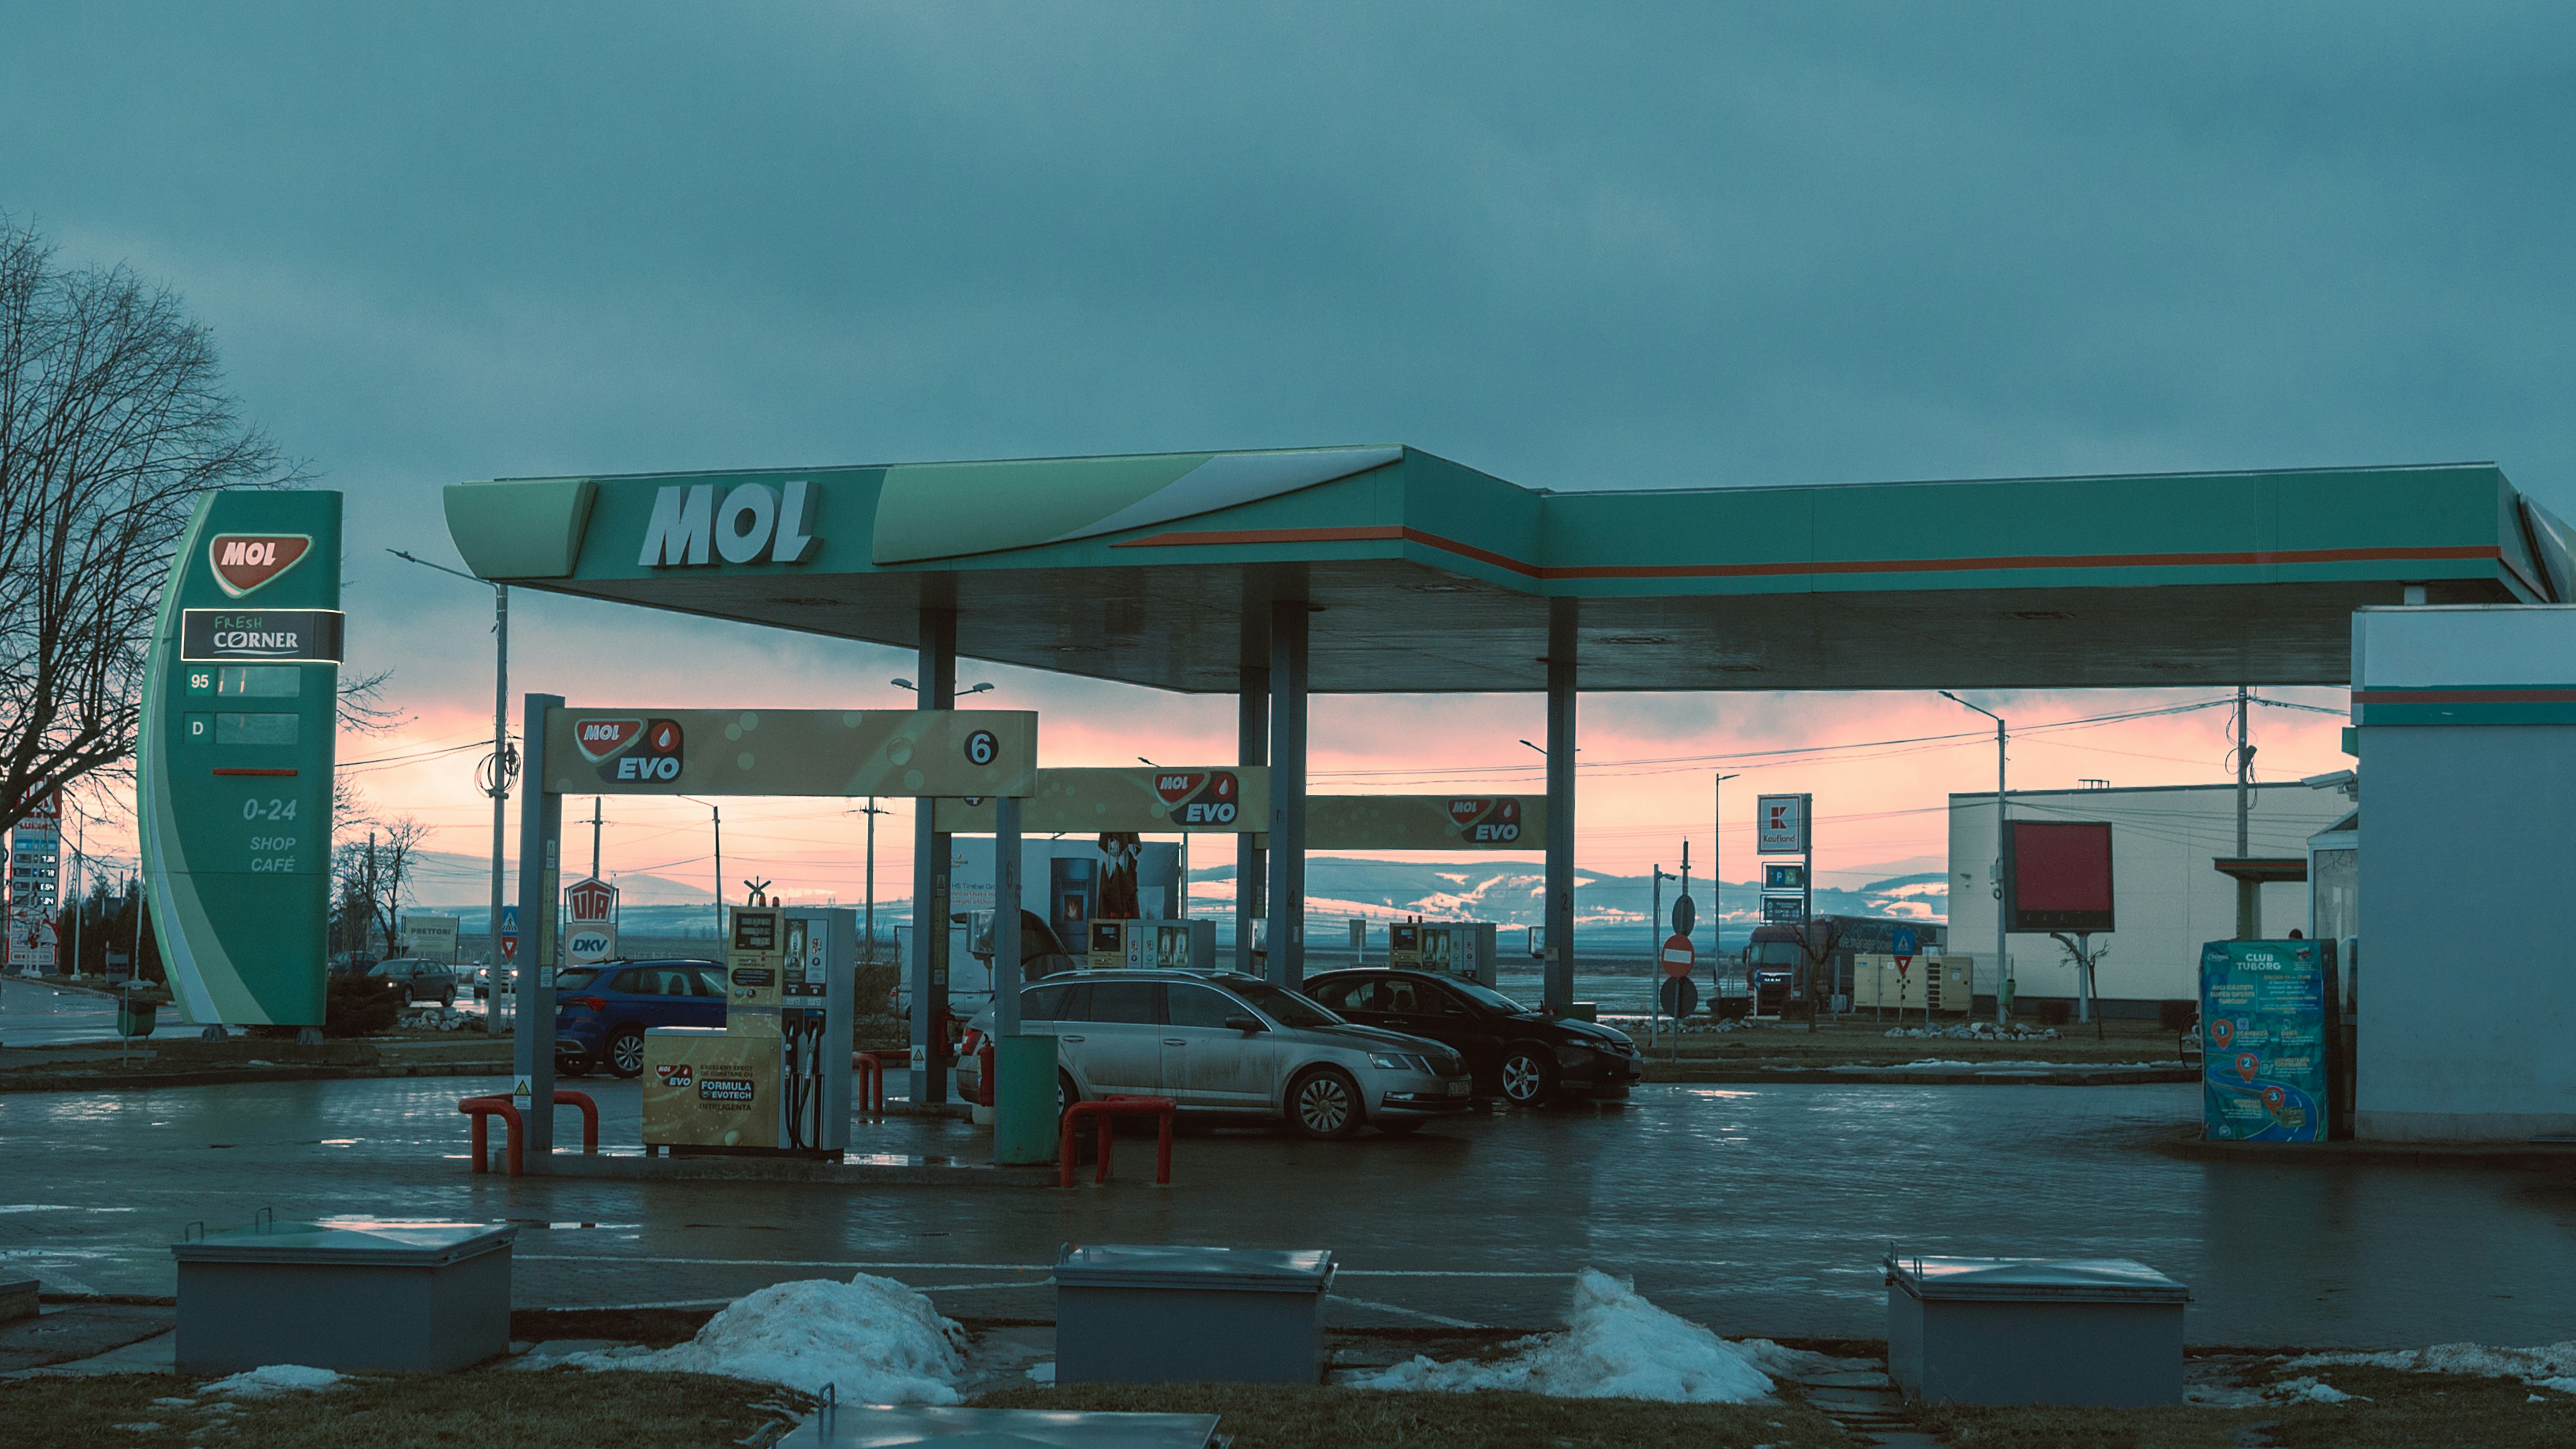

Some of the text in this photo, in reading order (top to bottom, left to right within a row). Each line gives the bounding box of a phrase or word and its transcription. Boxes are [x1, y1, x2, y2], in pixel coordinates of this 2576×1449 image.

[638, 481, 824, 568] MOL
[221, 542, 276, 566] MOL
[214, 616, 263, 630] FRESH
[213, 631, 298, 649] CORNER
[191, 674, 209, 688] 95
[193, 722, 204, 735] D
[584, 724, 619, 741] MOL
[971, 733, 991, 763] 6
[617, 757, 680, 780] EVO
[1159, 776, 1188, 790] MOL
[243, 799, 297, 821] 0-24
[1185, 803, 1236, 823] EVO
[1452, 801, 1477, 814] MOL
[1475, 823, 1519, 841] EVO
[1763, 834, 1795, 843] Kaufland
[250, 838, 296, 851] SHOP
[251, 856, 295, 873] CAFÉ
[572, 881, 611, 919] UTA
[573, 940, 608, 951] DKV
[1876, 940, 1893, 952] powe
[2246, 953, 2274, 962] CLUB
[2236, 962, 2281, 970] TUBORG
[2219, 1025, 2224, 1035] 1
[2243, 1058, 2251, 1067] 2
[669, 1078, 691, 1086] EVO
[701, 1081, 751, 1091] FORMULA
[712, 1091, 751, 1100] EVOTECH
[2270, 1091, 2278, 1101] 3
